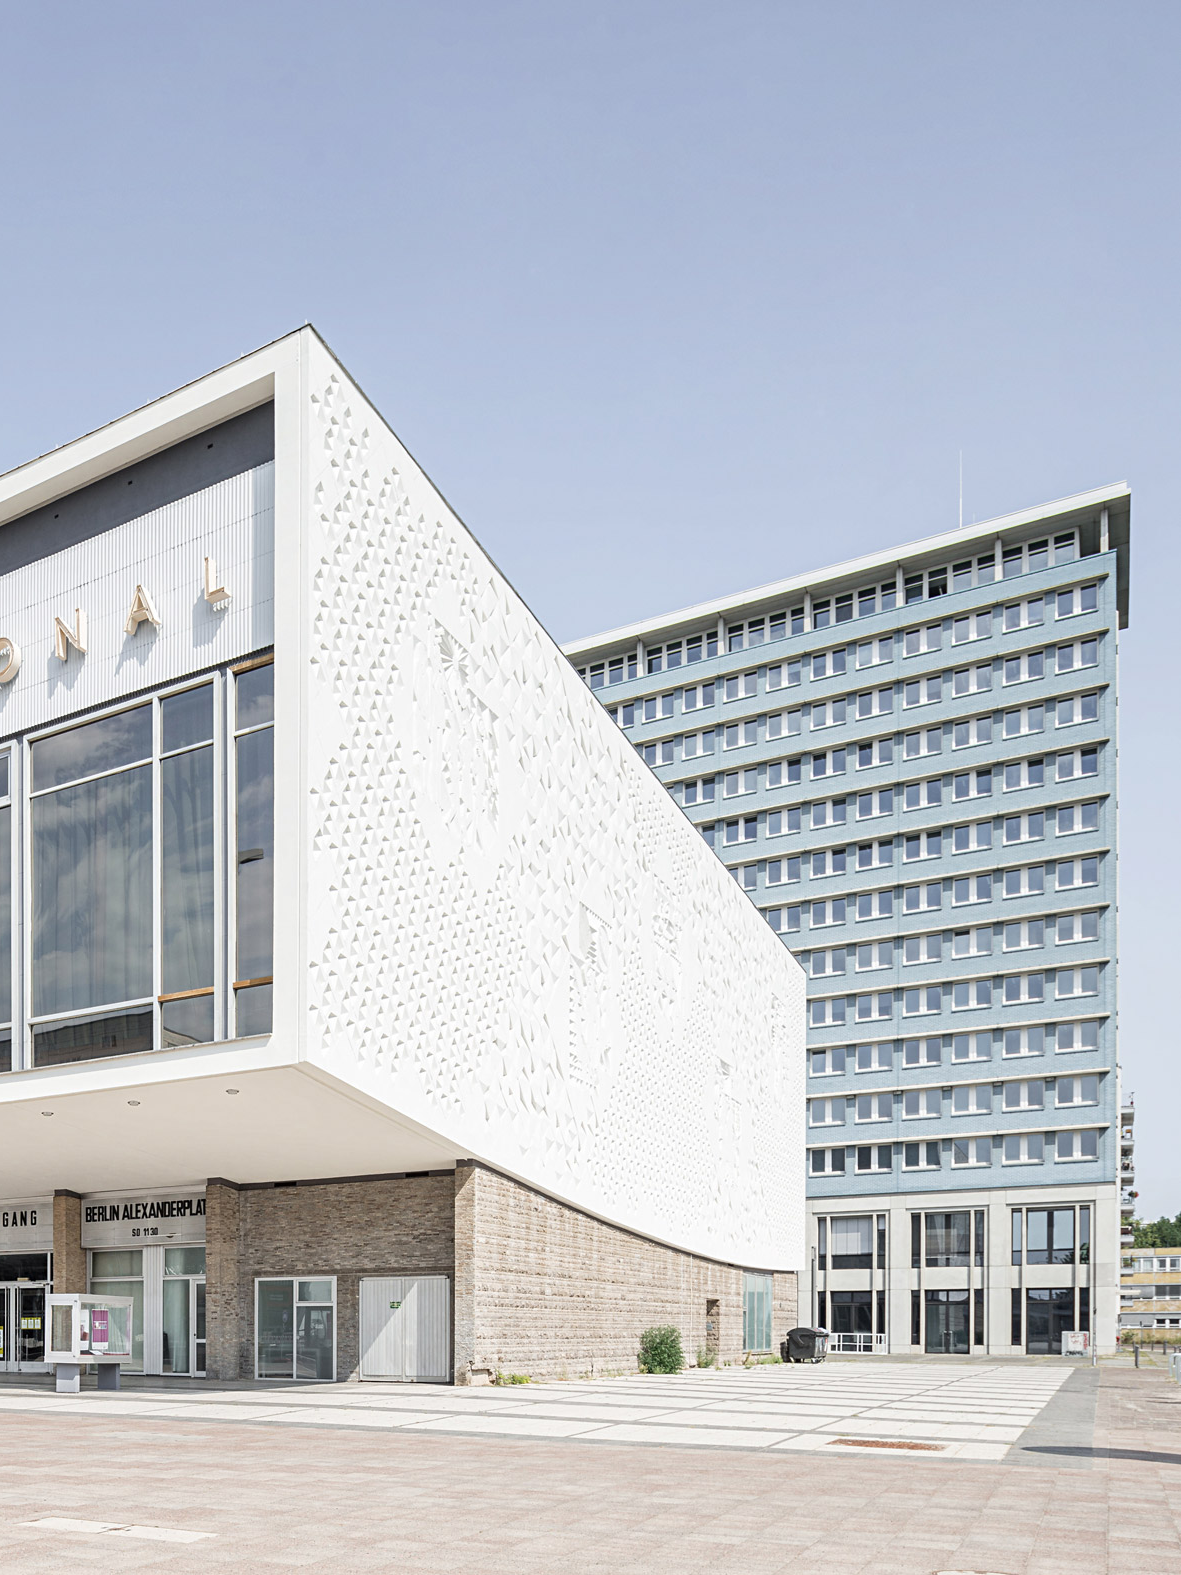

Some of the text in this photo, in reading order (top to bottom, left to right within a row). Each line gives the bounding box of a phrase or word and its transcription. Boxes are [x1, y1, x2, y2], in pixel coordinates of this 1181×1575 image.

[85, 1204, 120, 1223] BERLIN
[131, 1226, 159, 1237] SO 1130
